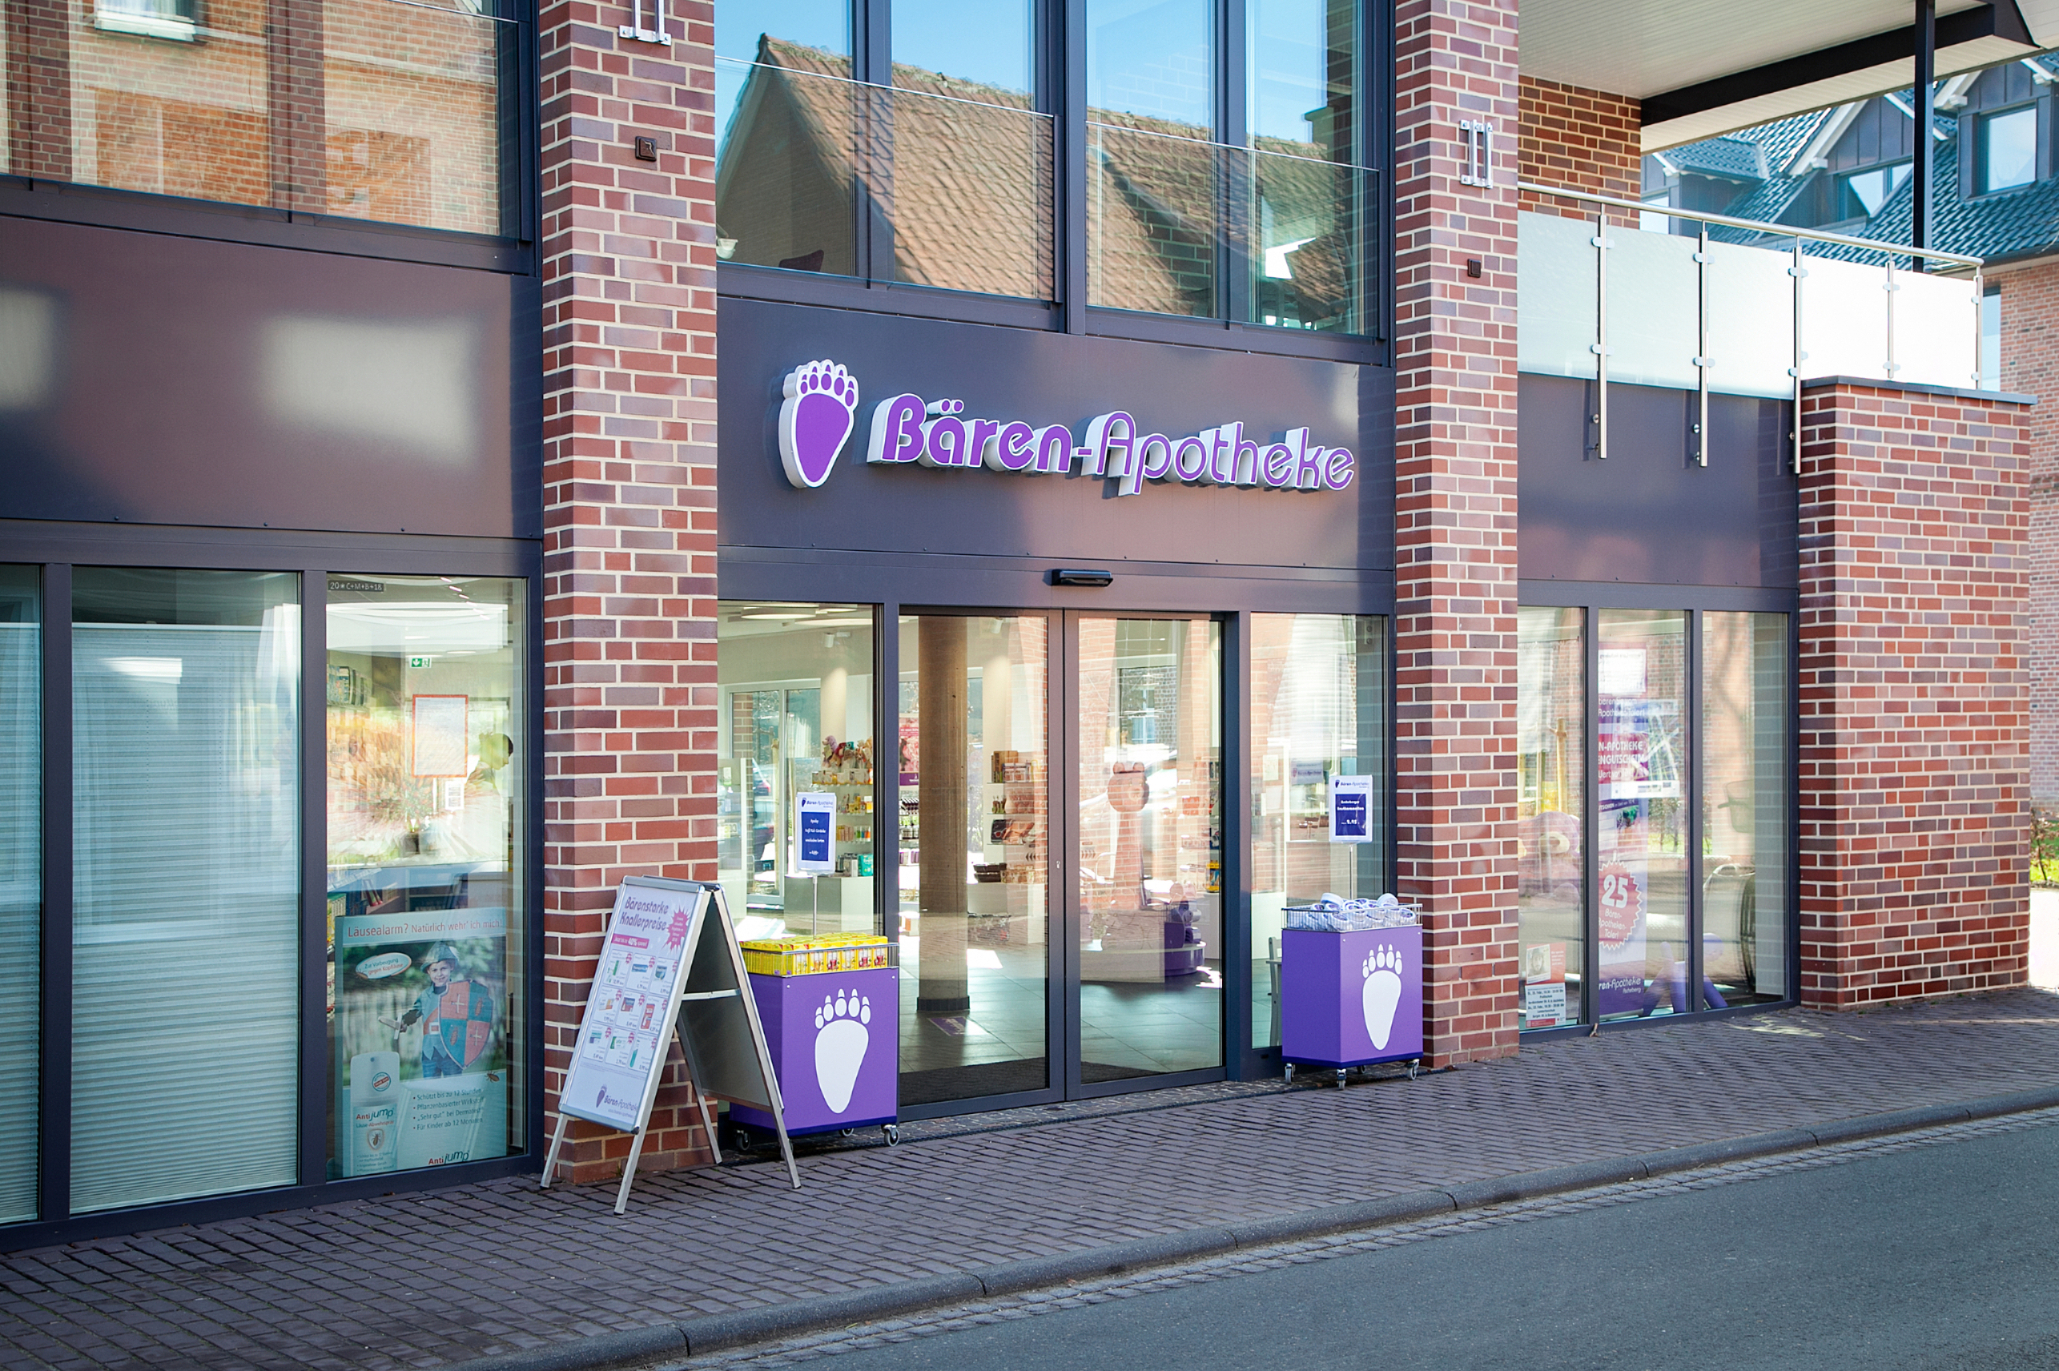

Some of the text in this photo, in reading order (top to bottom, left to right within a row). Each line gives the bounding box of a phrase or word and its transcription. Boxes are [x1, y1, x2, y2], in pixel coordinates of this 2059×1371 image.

[868, 393, 1355, 496] Bären-Apotheke
[1601, 874, 1629, 909] 25
[624, 896, 669, 915] Bärenstarke
[348, 923, 409, 938] Läusealarm?
[411, 923, 446, 933] Natürlich
[470, 920, 481, 930] ich
[619, 911, 668, 932] Knallerpreise
[603, 1095, 638, 1111] Bären-Apothek
